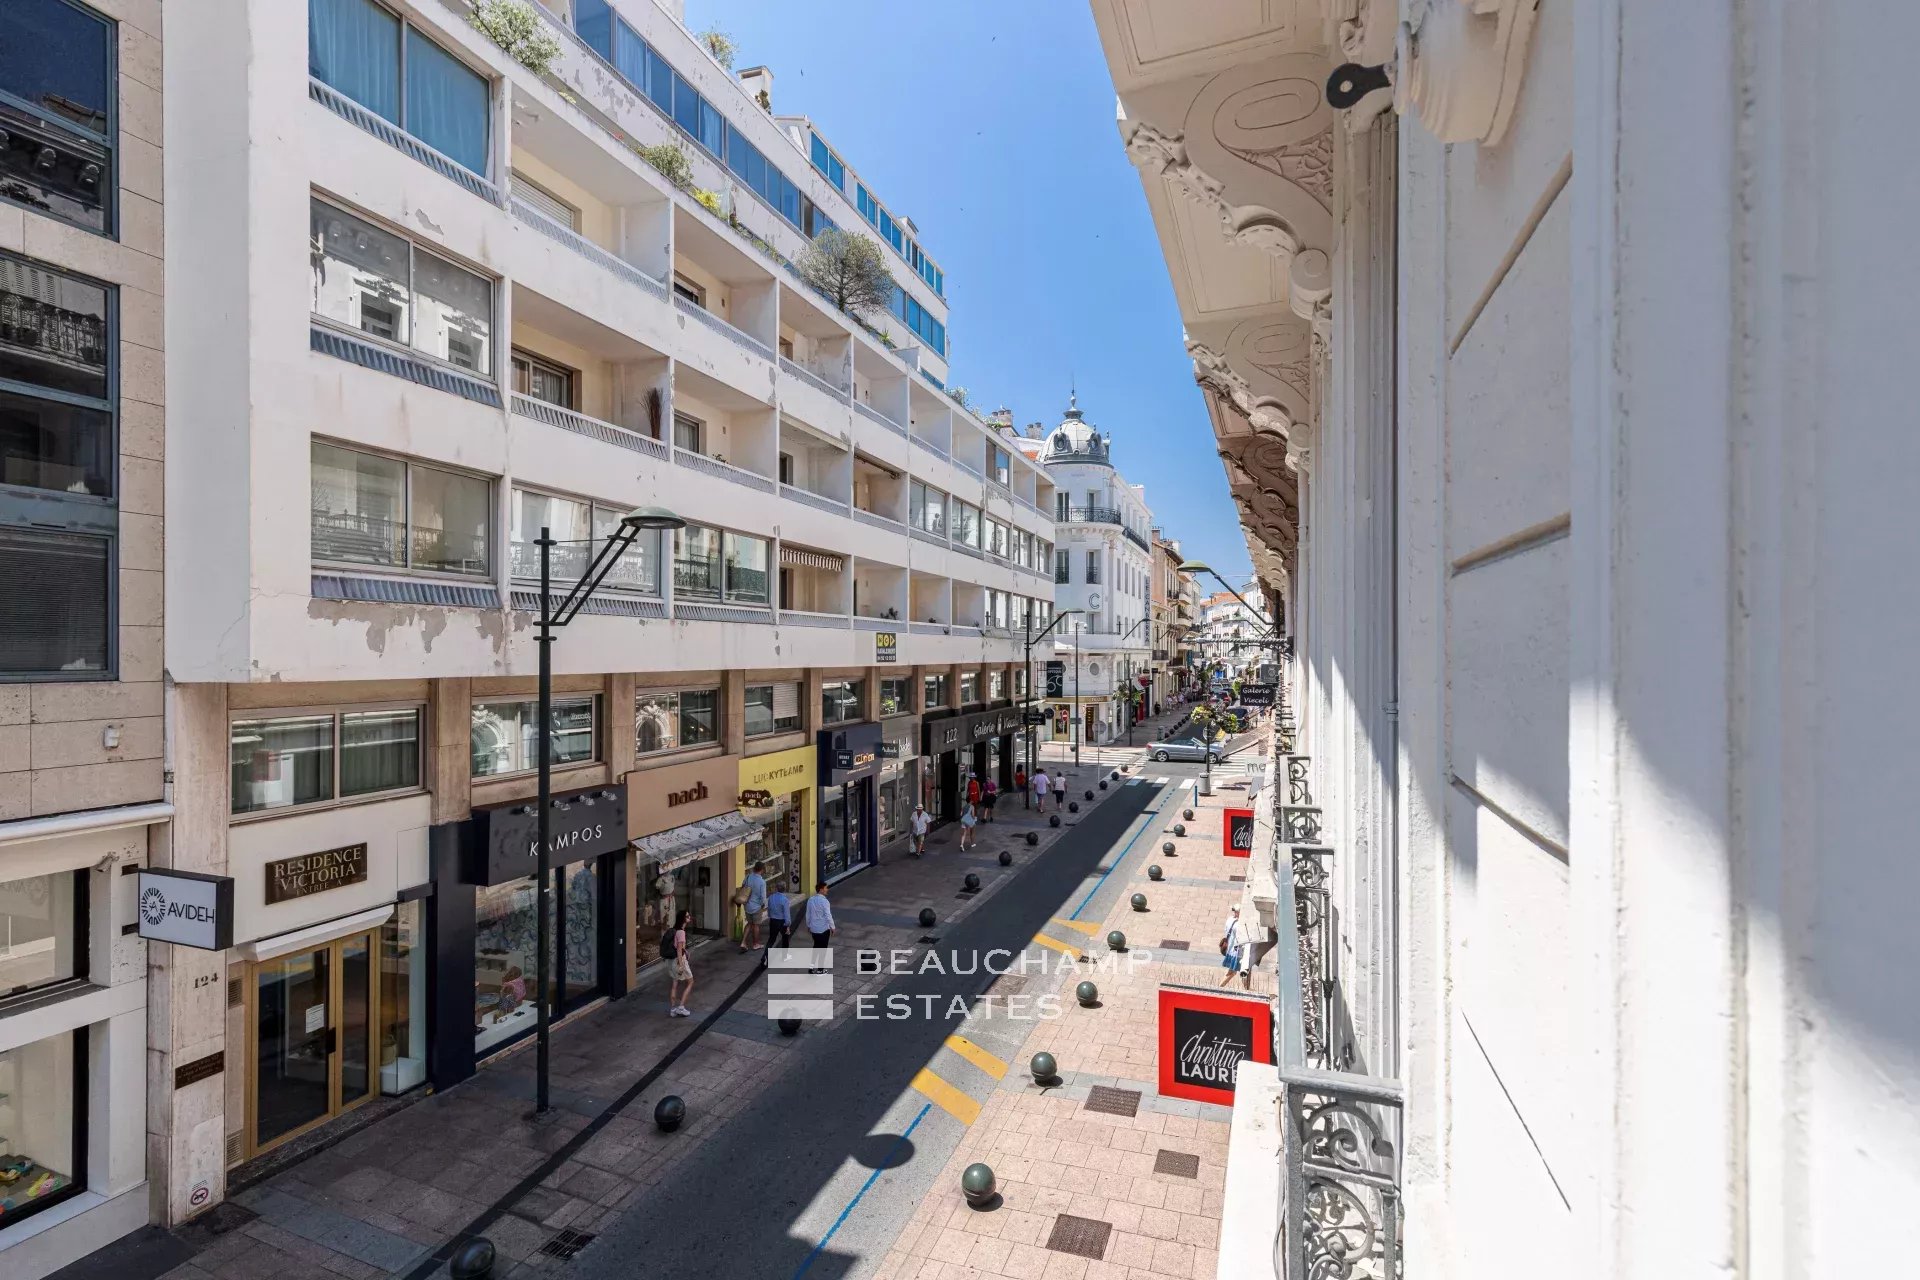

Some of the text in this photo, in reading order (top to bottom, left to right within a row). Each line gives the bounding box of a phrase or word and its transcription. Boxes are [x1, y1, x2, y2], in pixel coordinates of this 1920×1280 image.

[946, 728, 958, 744] 122
[667, 781, 709, 808] nach
[529, 824, 602, 857] KMPOS
[274, 847, 362, 878] RESIDENCE
[280, 863, 356, 891] VICTORIA
[167, 902, 216, 924] AVIDEH
[193, 972, 219, 989] 124
[1181, 1030, 1247, 1069] Christine
